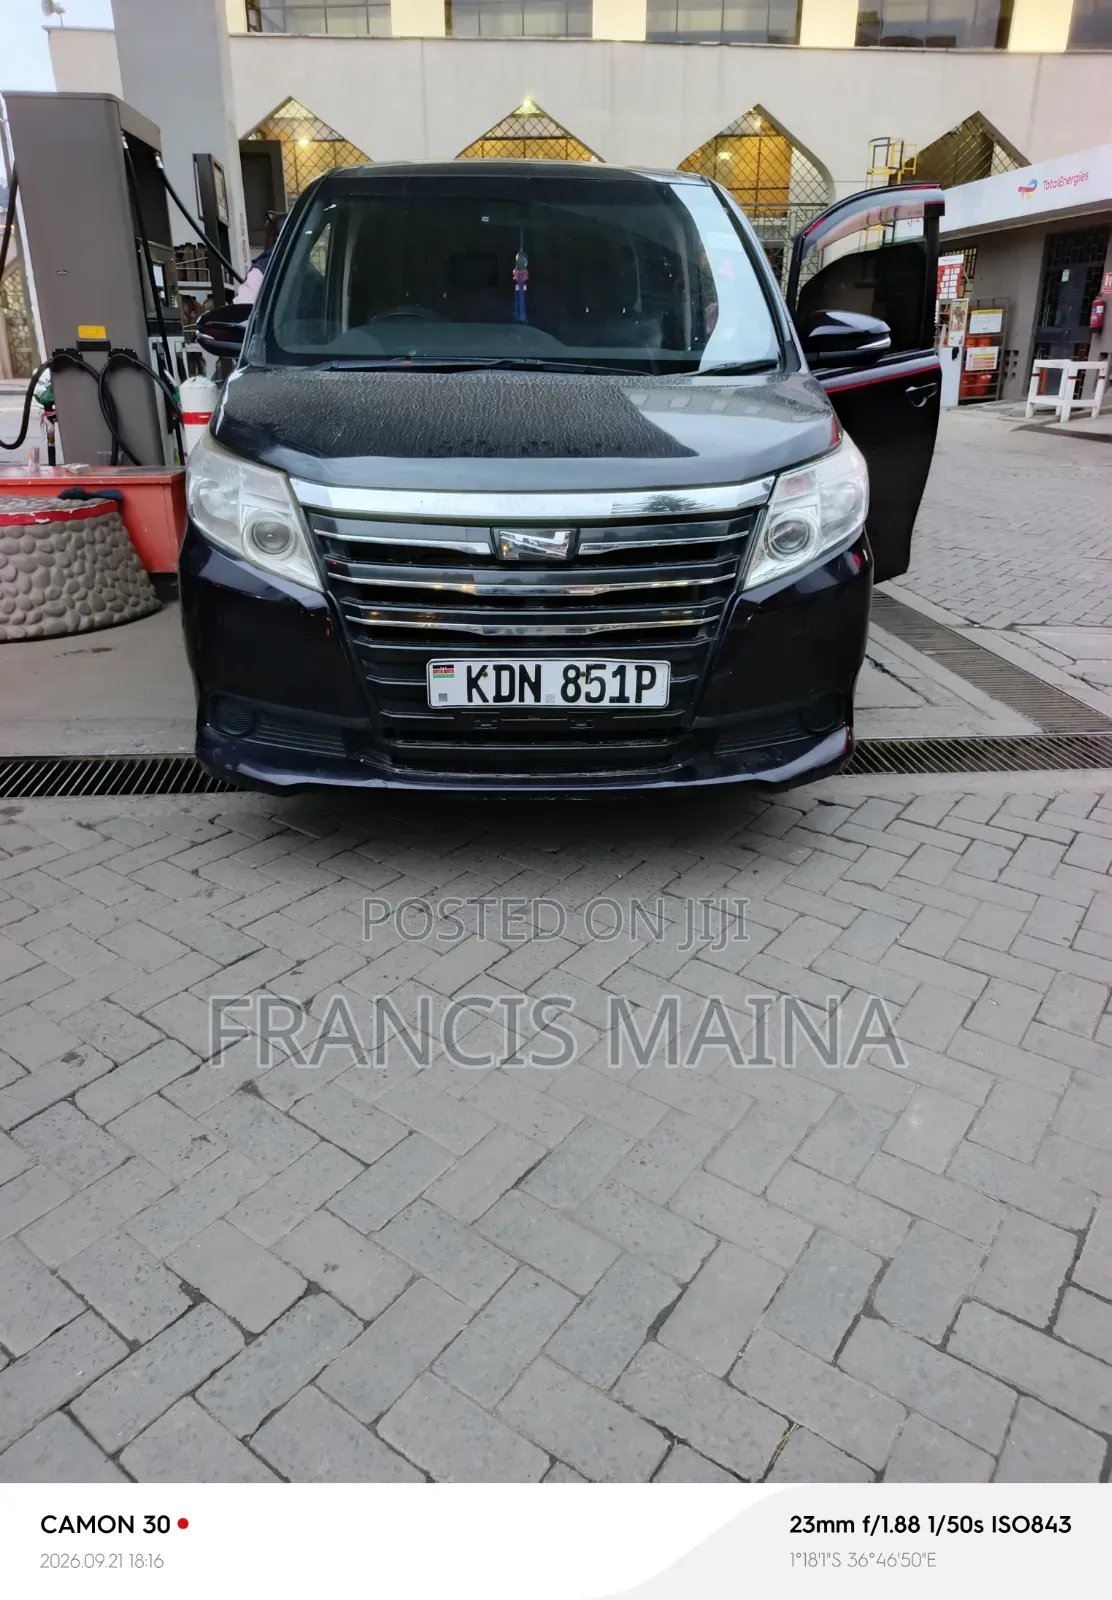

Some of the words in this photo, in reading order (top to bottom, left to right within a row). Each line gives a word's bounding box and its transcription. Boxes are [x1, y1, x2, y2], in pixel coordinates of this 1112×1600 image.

[1042, 171, 1089, 191] TotalEnergies
[466, 664, 541, 703] KDN
[561, 664, 656, 703] 851P
